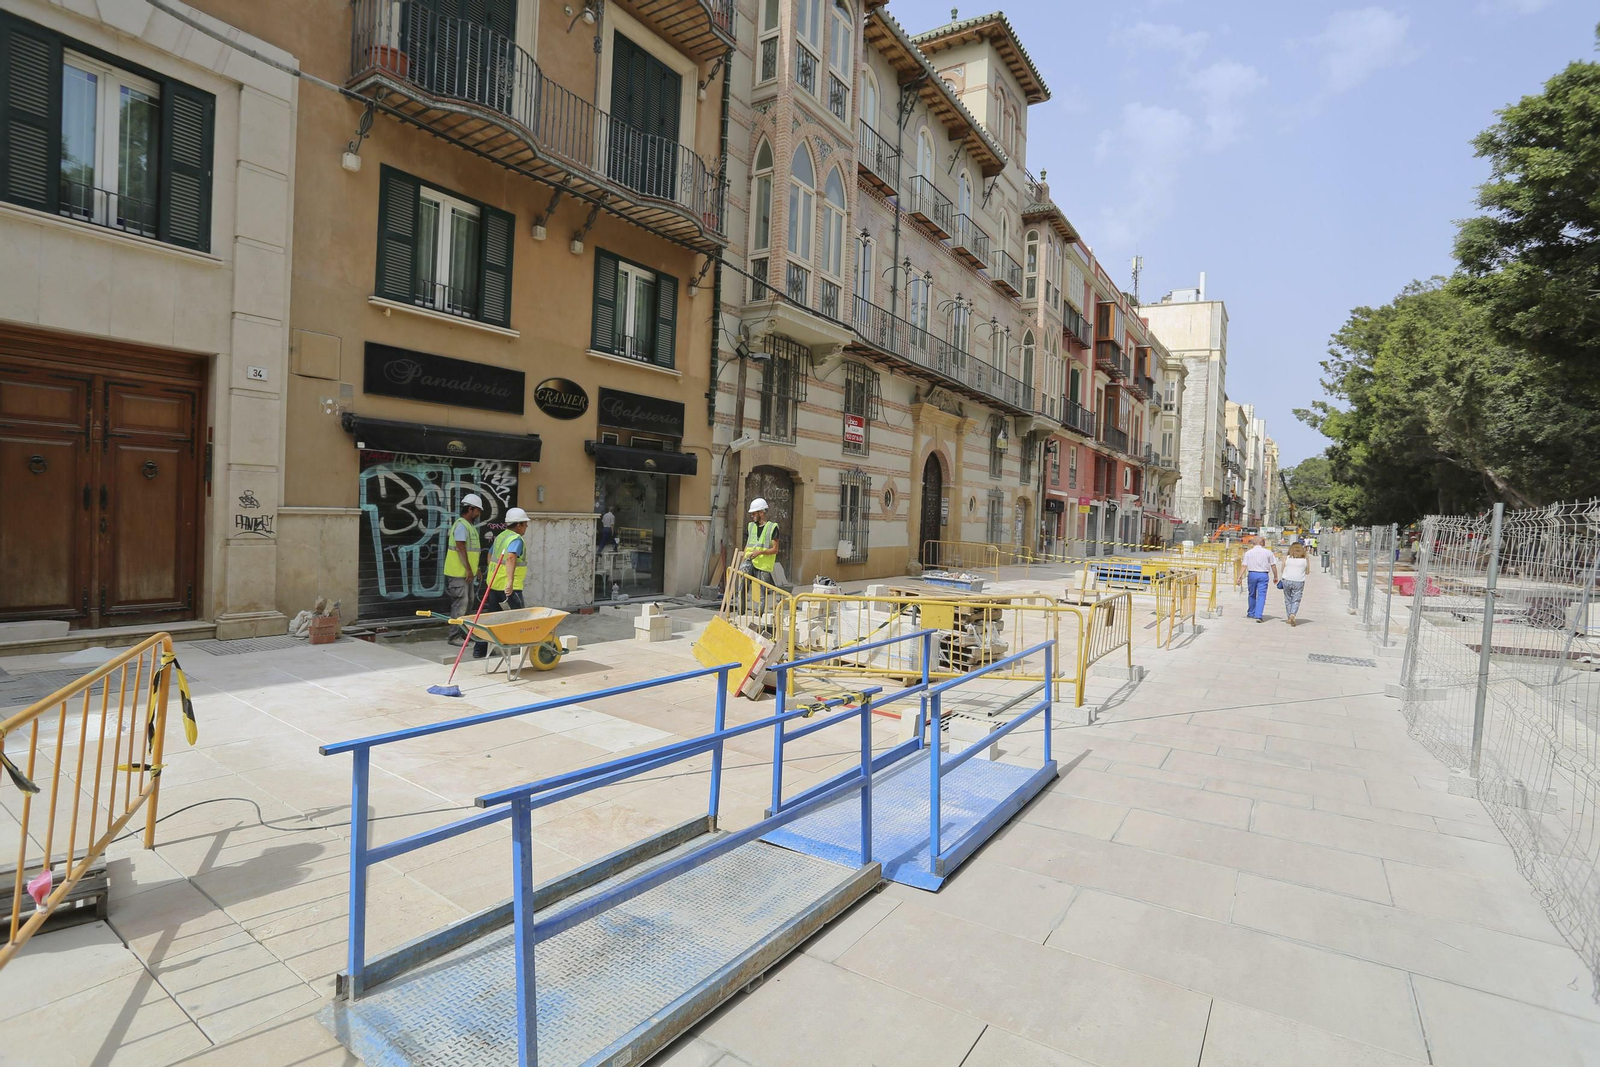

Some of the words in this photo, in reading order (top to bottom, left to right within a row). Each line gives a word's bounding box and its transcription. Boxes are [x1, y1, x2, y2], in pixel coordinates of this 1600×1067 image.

[252, 368, 263, 378] 34
[383, 358, 512, 398] Panadería
[535, 389, 587, 410] GRANIER
[601, 396, 681, 426] Cafetería
